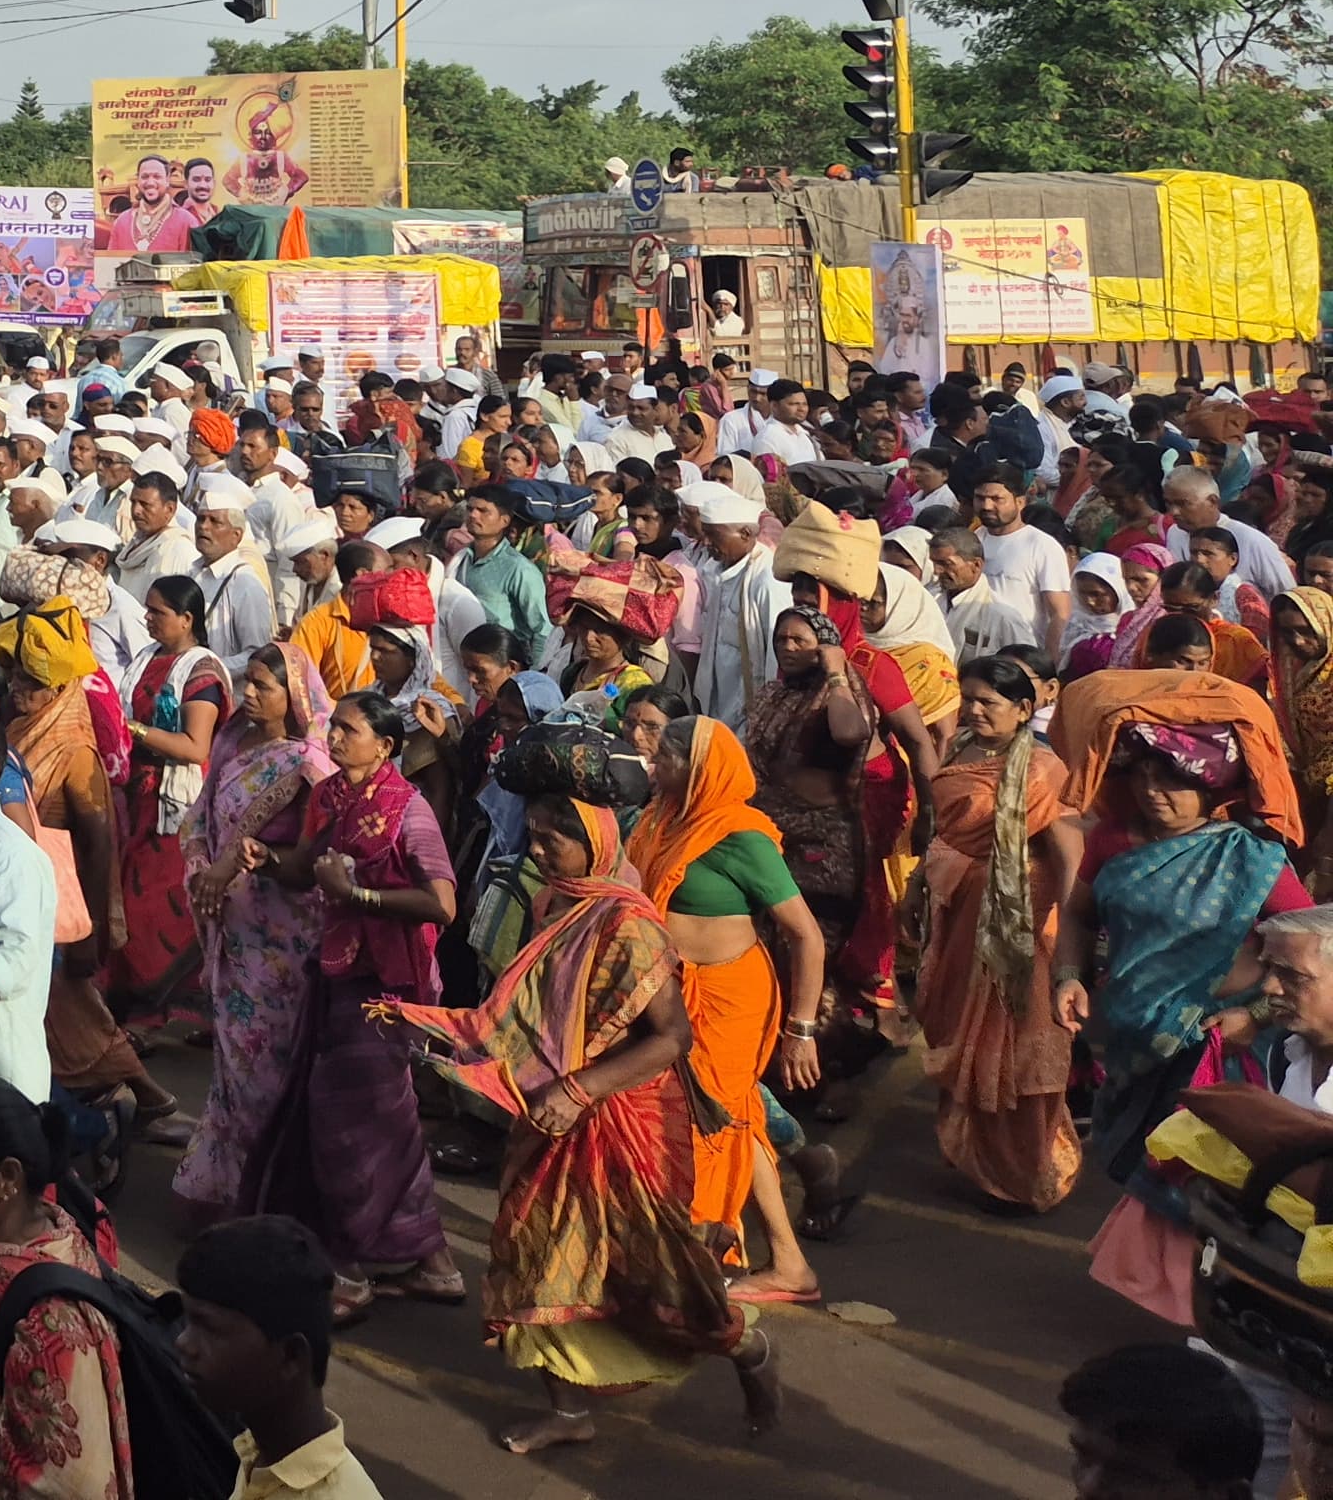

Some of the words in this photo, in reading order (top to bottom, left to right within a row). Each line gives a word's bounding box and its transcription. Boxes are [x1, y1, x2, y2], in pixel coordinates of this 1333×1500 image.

[178, 85, 197, 97] श्री
[97, 98, 150, 110] ज्ञानेश्वर
[153, 96, 228, 110] महाराजांचा
[163, 107, 215, 118] पालखी
[132, 120, 178, 131] सोहळा
[538, 199, 622, 235] mahavir
